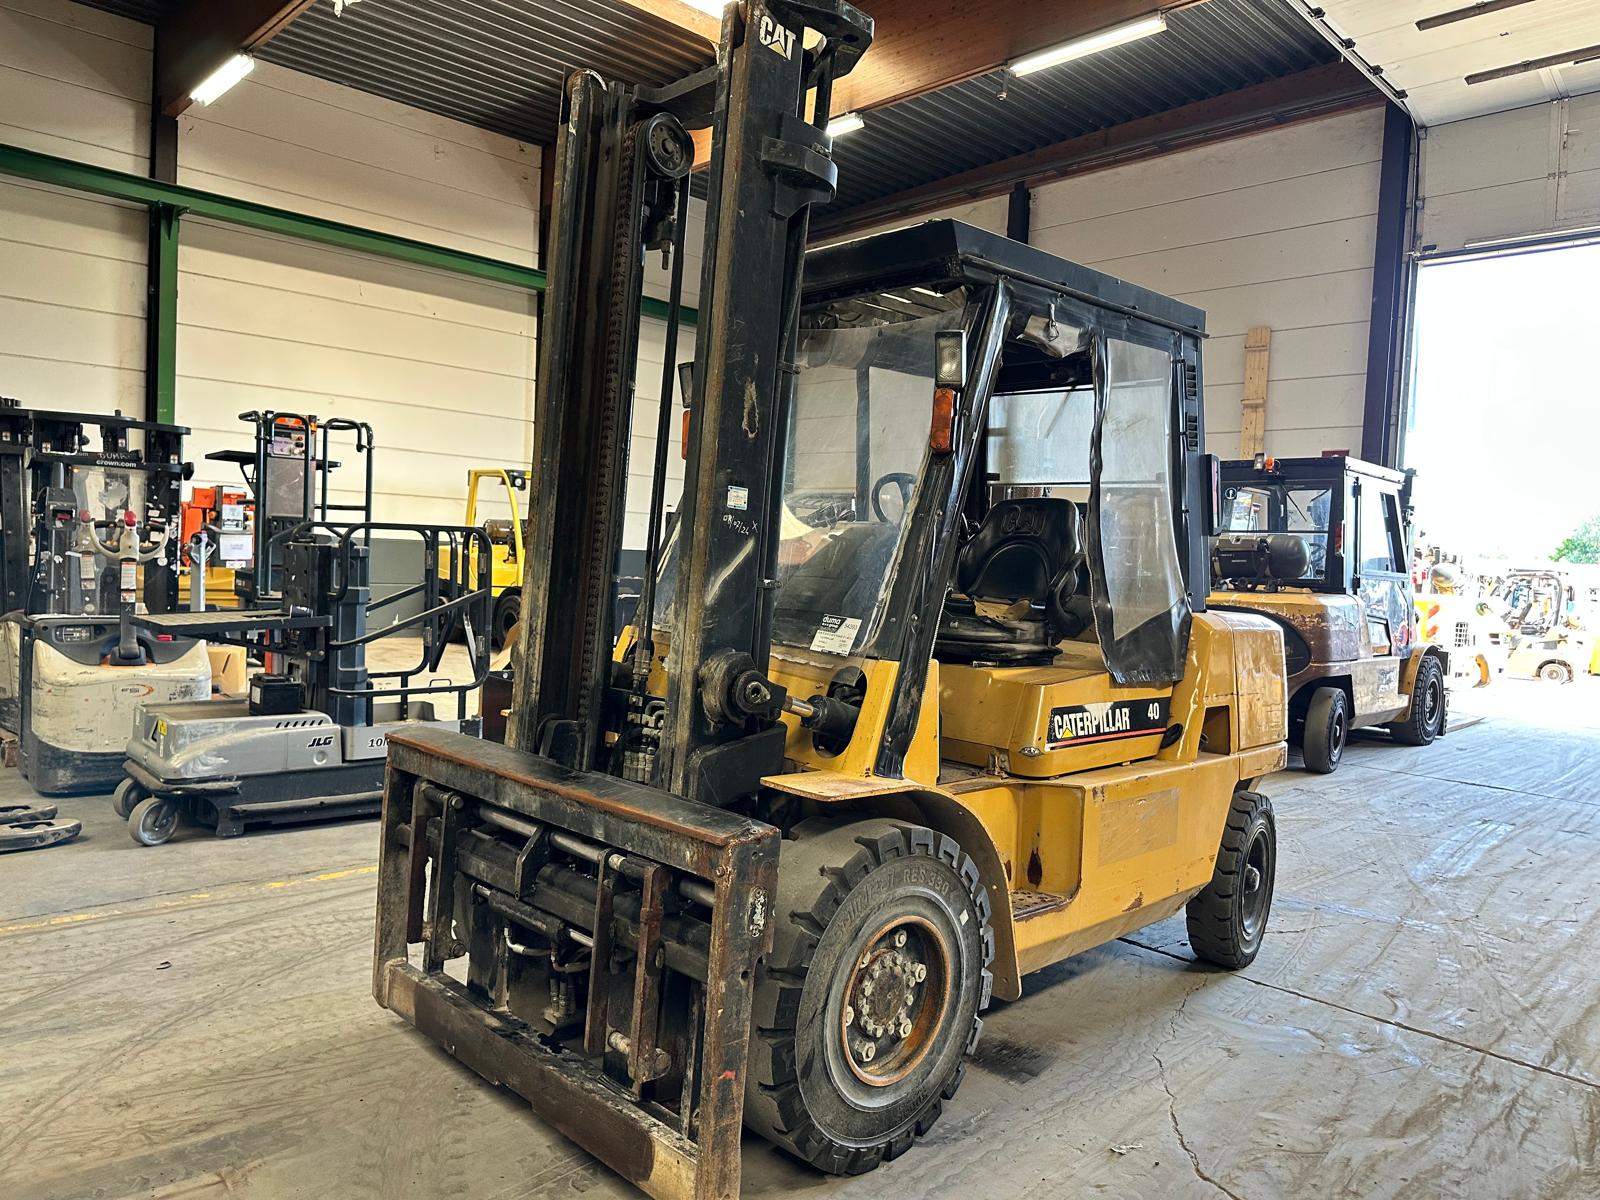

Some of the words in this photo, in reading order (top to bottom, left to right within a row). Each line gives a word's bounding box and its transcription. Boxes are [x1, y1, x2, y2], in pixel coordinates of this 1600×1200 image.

[760, 15, 796, 60] CAT
[96, 459, 137, 468] crown.com
[822, 616, 841, 625] duma
[1054, 707, 1130, 740] CATERPILLAR
[1147, 702, 1160, 720] 40
[307, 735, 333, 749] JLG
